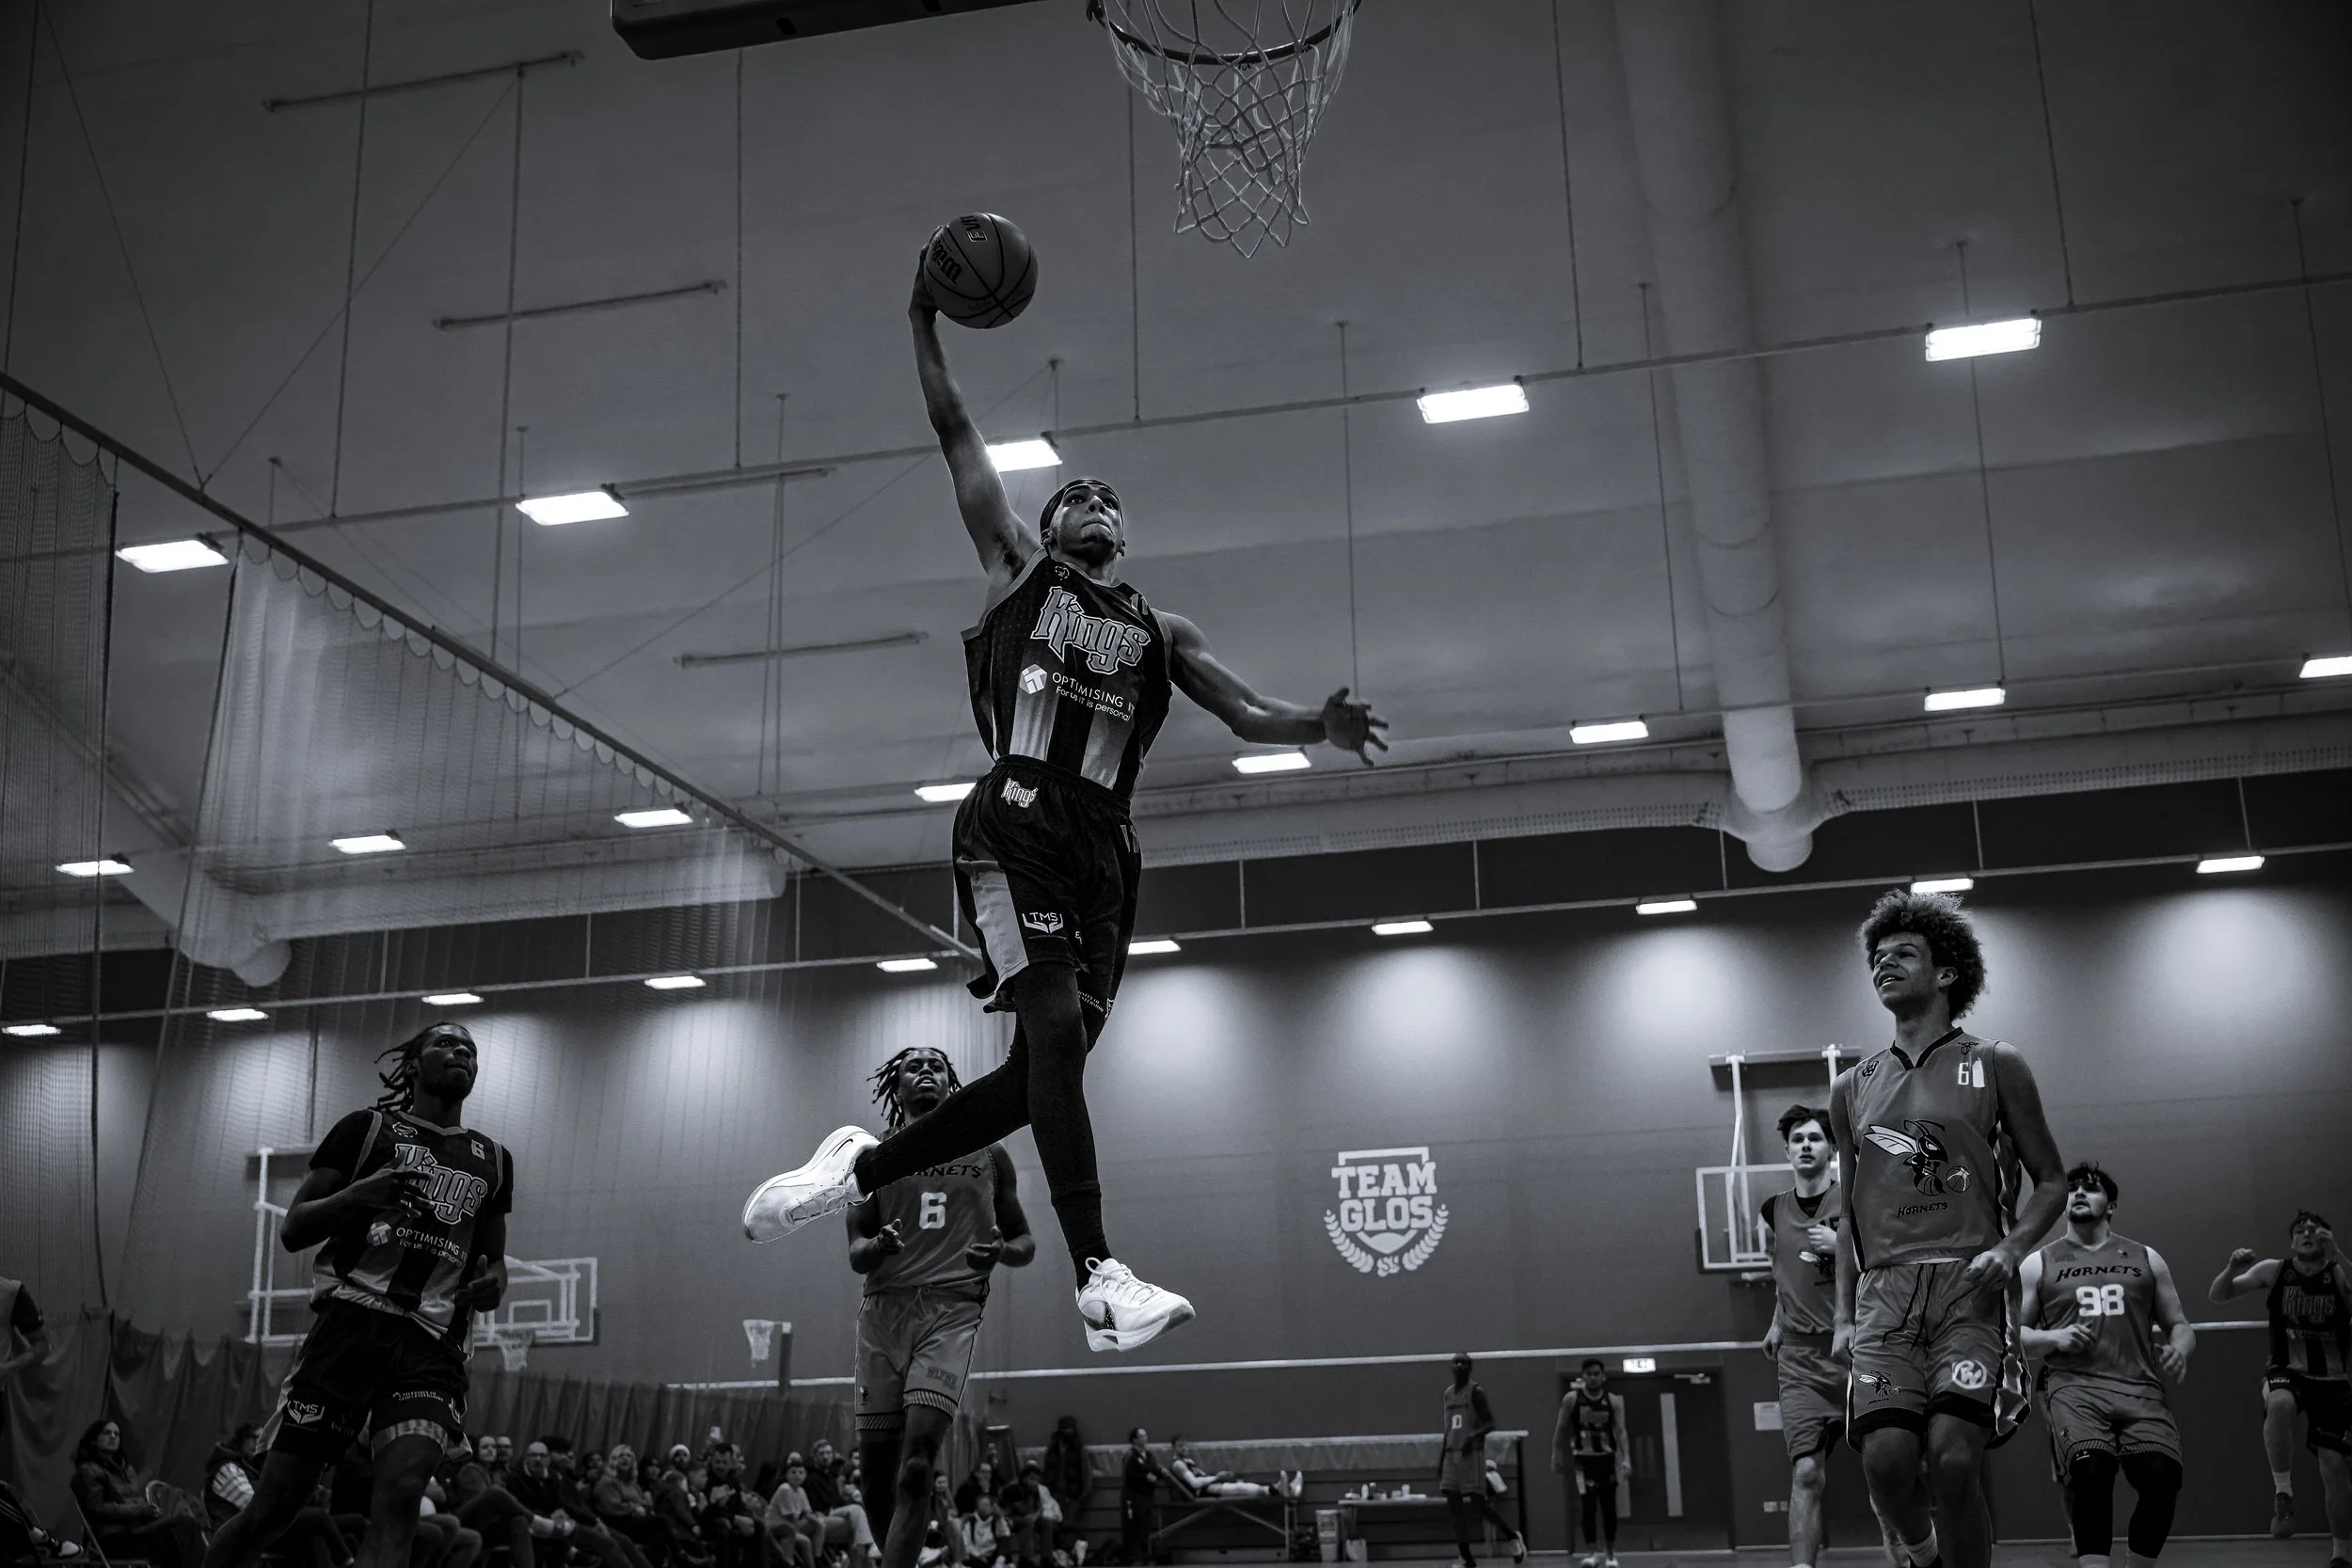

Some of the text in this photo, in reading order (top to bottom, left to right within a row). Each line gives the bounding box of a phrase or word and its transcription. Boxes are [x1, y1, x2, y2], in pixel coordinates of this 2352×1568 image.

[1030, 586, 1152, 675] Kings
[1052, 672, 1124, 707] OPTIMISING
[1056, 686, 1070, 697] For
[1070, 692, 1078, 701] us
[1086, 700, 1094, 708] is
[1094, 703, 1132, 721] personal
[1001, 778, 1038, 808] Kings
[1029, 911, 1058, 922] TMS
[470, 1138, 485, 1160] 6
[1331, 1162, 1438, 1199] TEAM
[918, 1192, 947, 1229] 6
[1340, 1196, 1434, 1232] GLOS
[396, 1227, 460, 1255] OPTIMISING
[2055, 1265, 2143, 1283] HORNETS
[2075, 1283, 2126, 1317] 98
[294, 1400, 319, 1414] TMS
